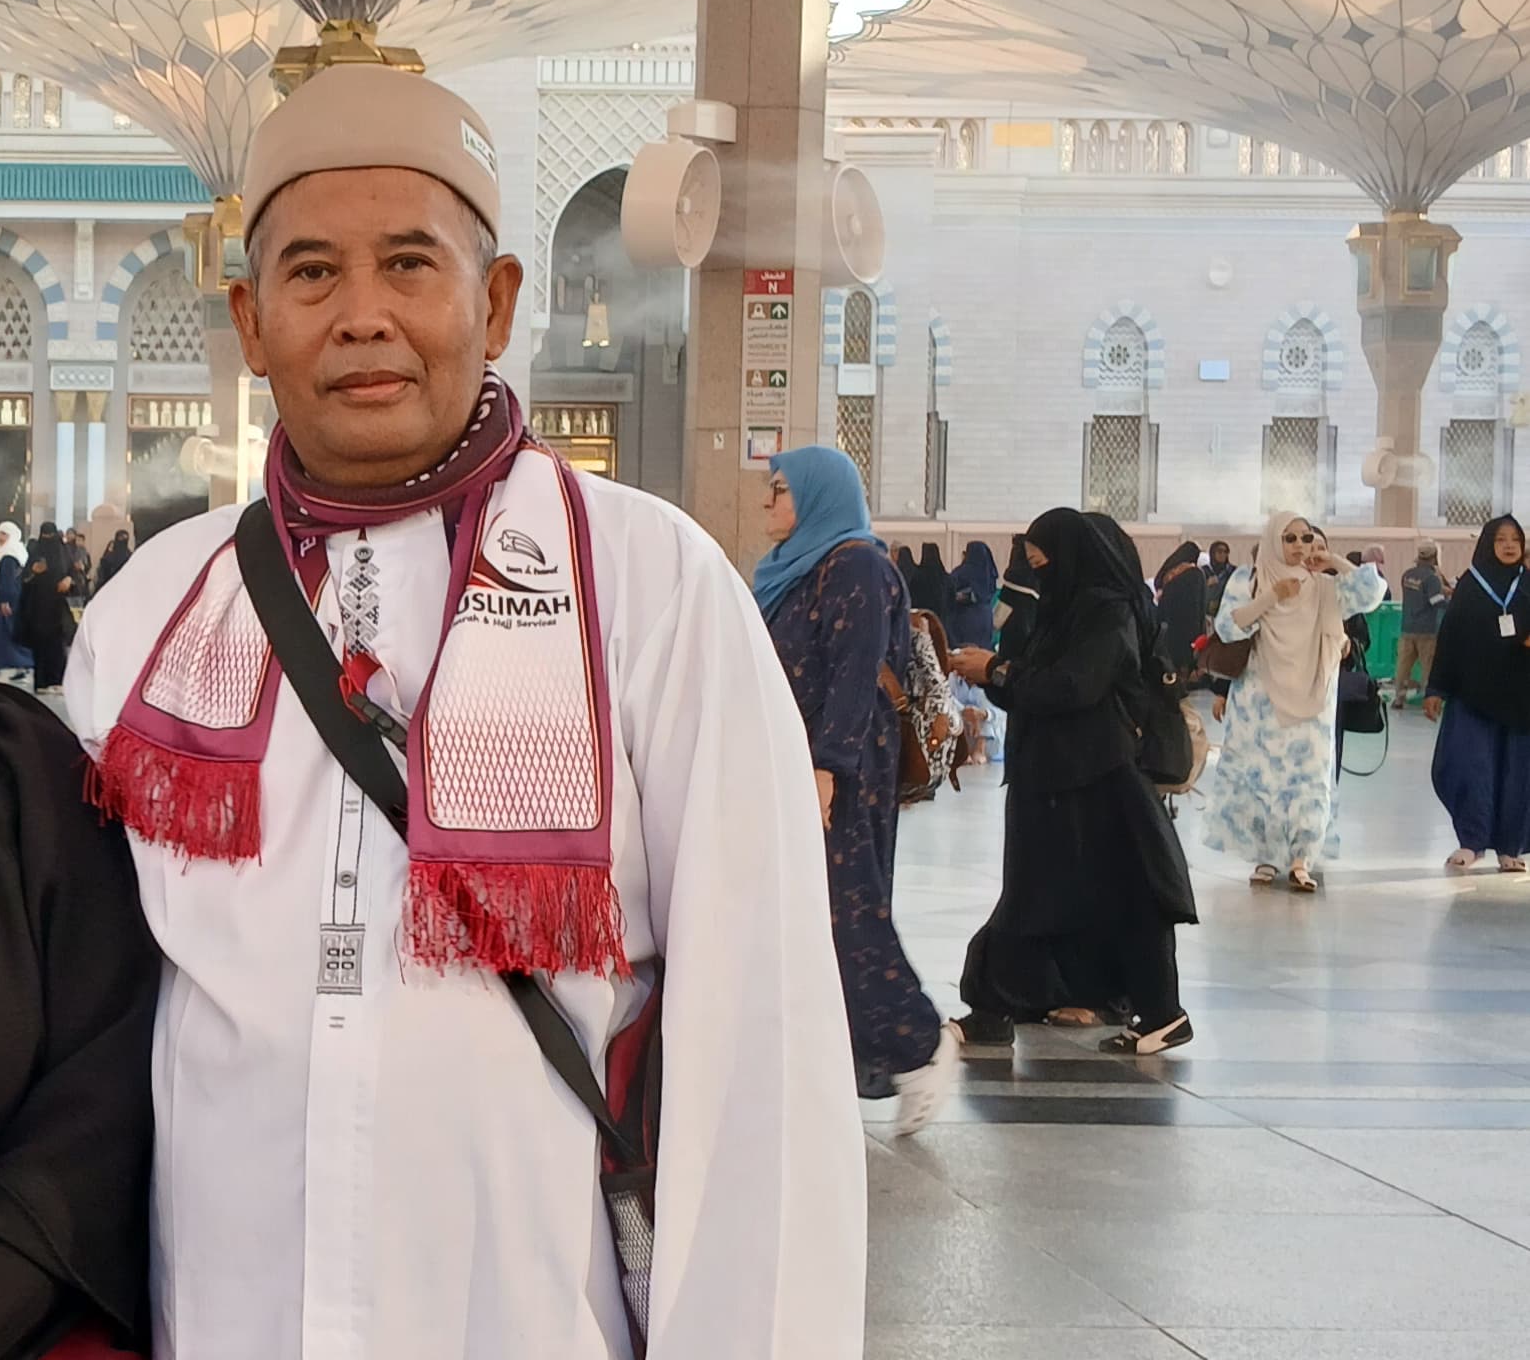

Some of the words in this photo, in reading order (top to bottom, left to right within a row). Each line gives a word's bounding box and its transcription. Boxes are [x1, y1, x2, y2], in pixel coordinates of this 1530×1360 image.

[768, 281, 778, 294] N
[493, 618, 512, 630] Hajj
[516, 618, 557, 628] Services
